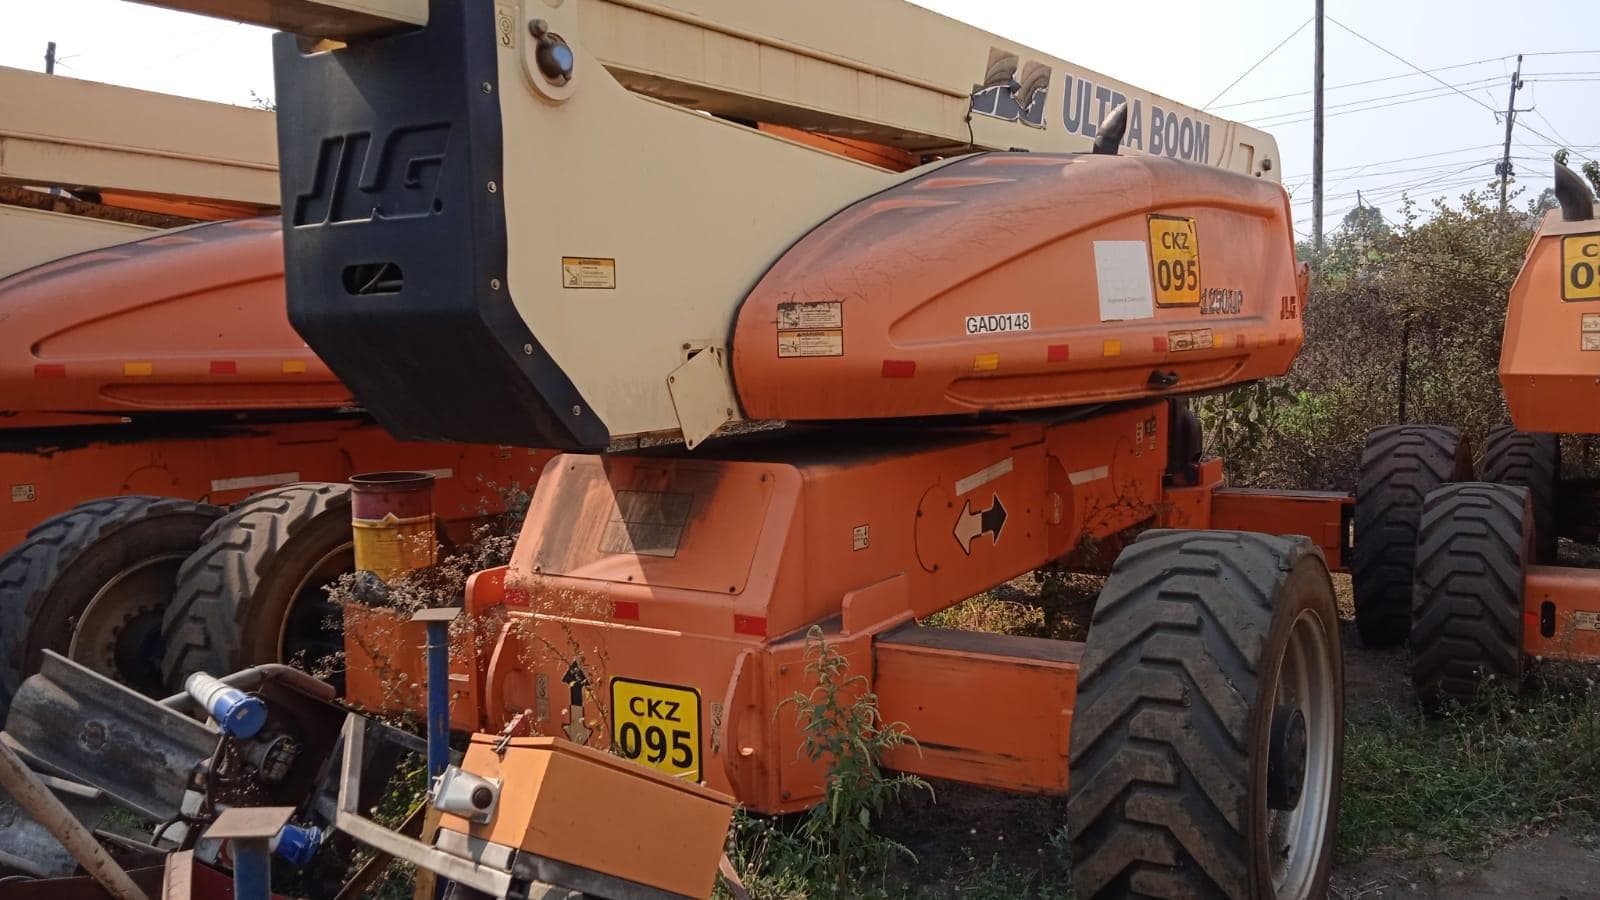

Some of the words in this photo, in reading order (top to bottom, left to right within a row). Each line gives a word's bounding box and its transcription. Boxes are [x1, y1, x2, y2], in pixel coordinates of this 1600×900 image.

[1149, 105, 1210, 165] BOOM
[293, 121, 451, 229] JLG
[1161, 231, 1190, 250] CKZ
[1157, 259, 1198, 291] 095
[1280, 295, 1296, 320] JLG
[966, 313, 1030, 334] GAD0148
[629, 696, 682, 723] CKZ
[619, 721, 694, 769] 095
